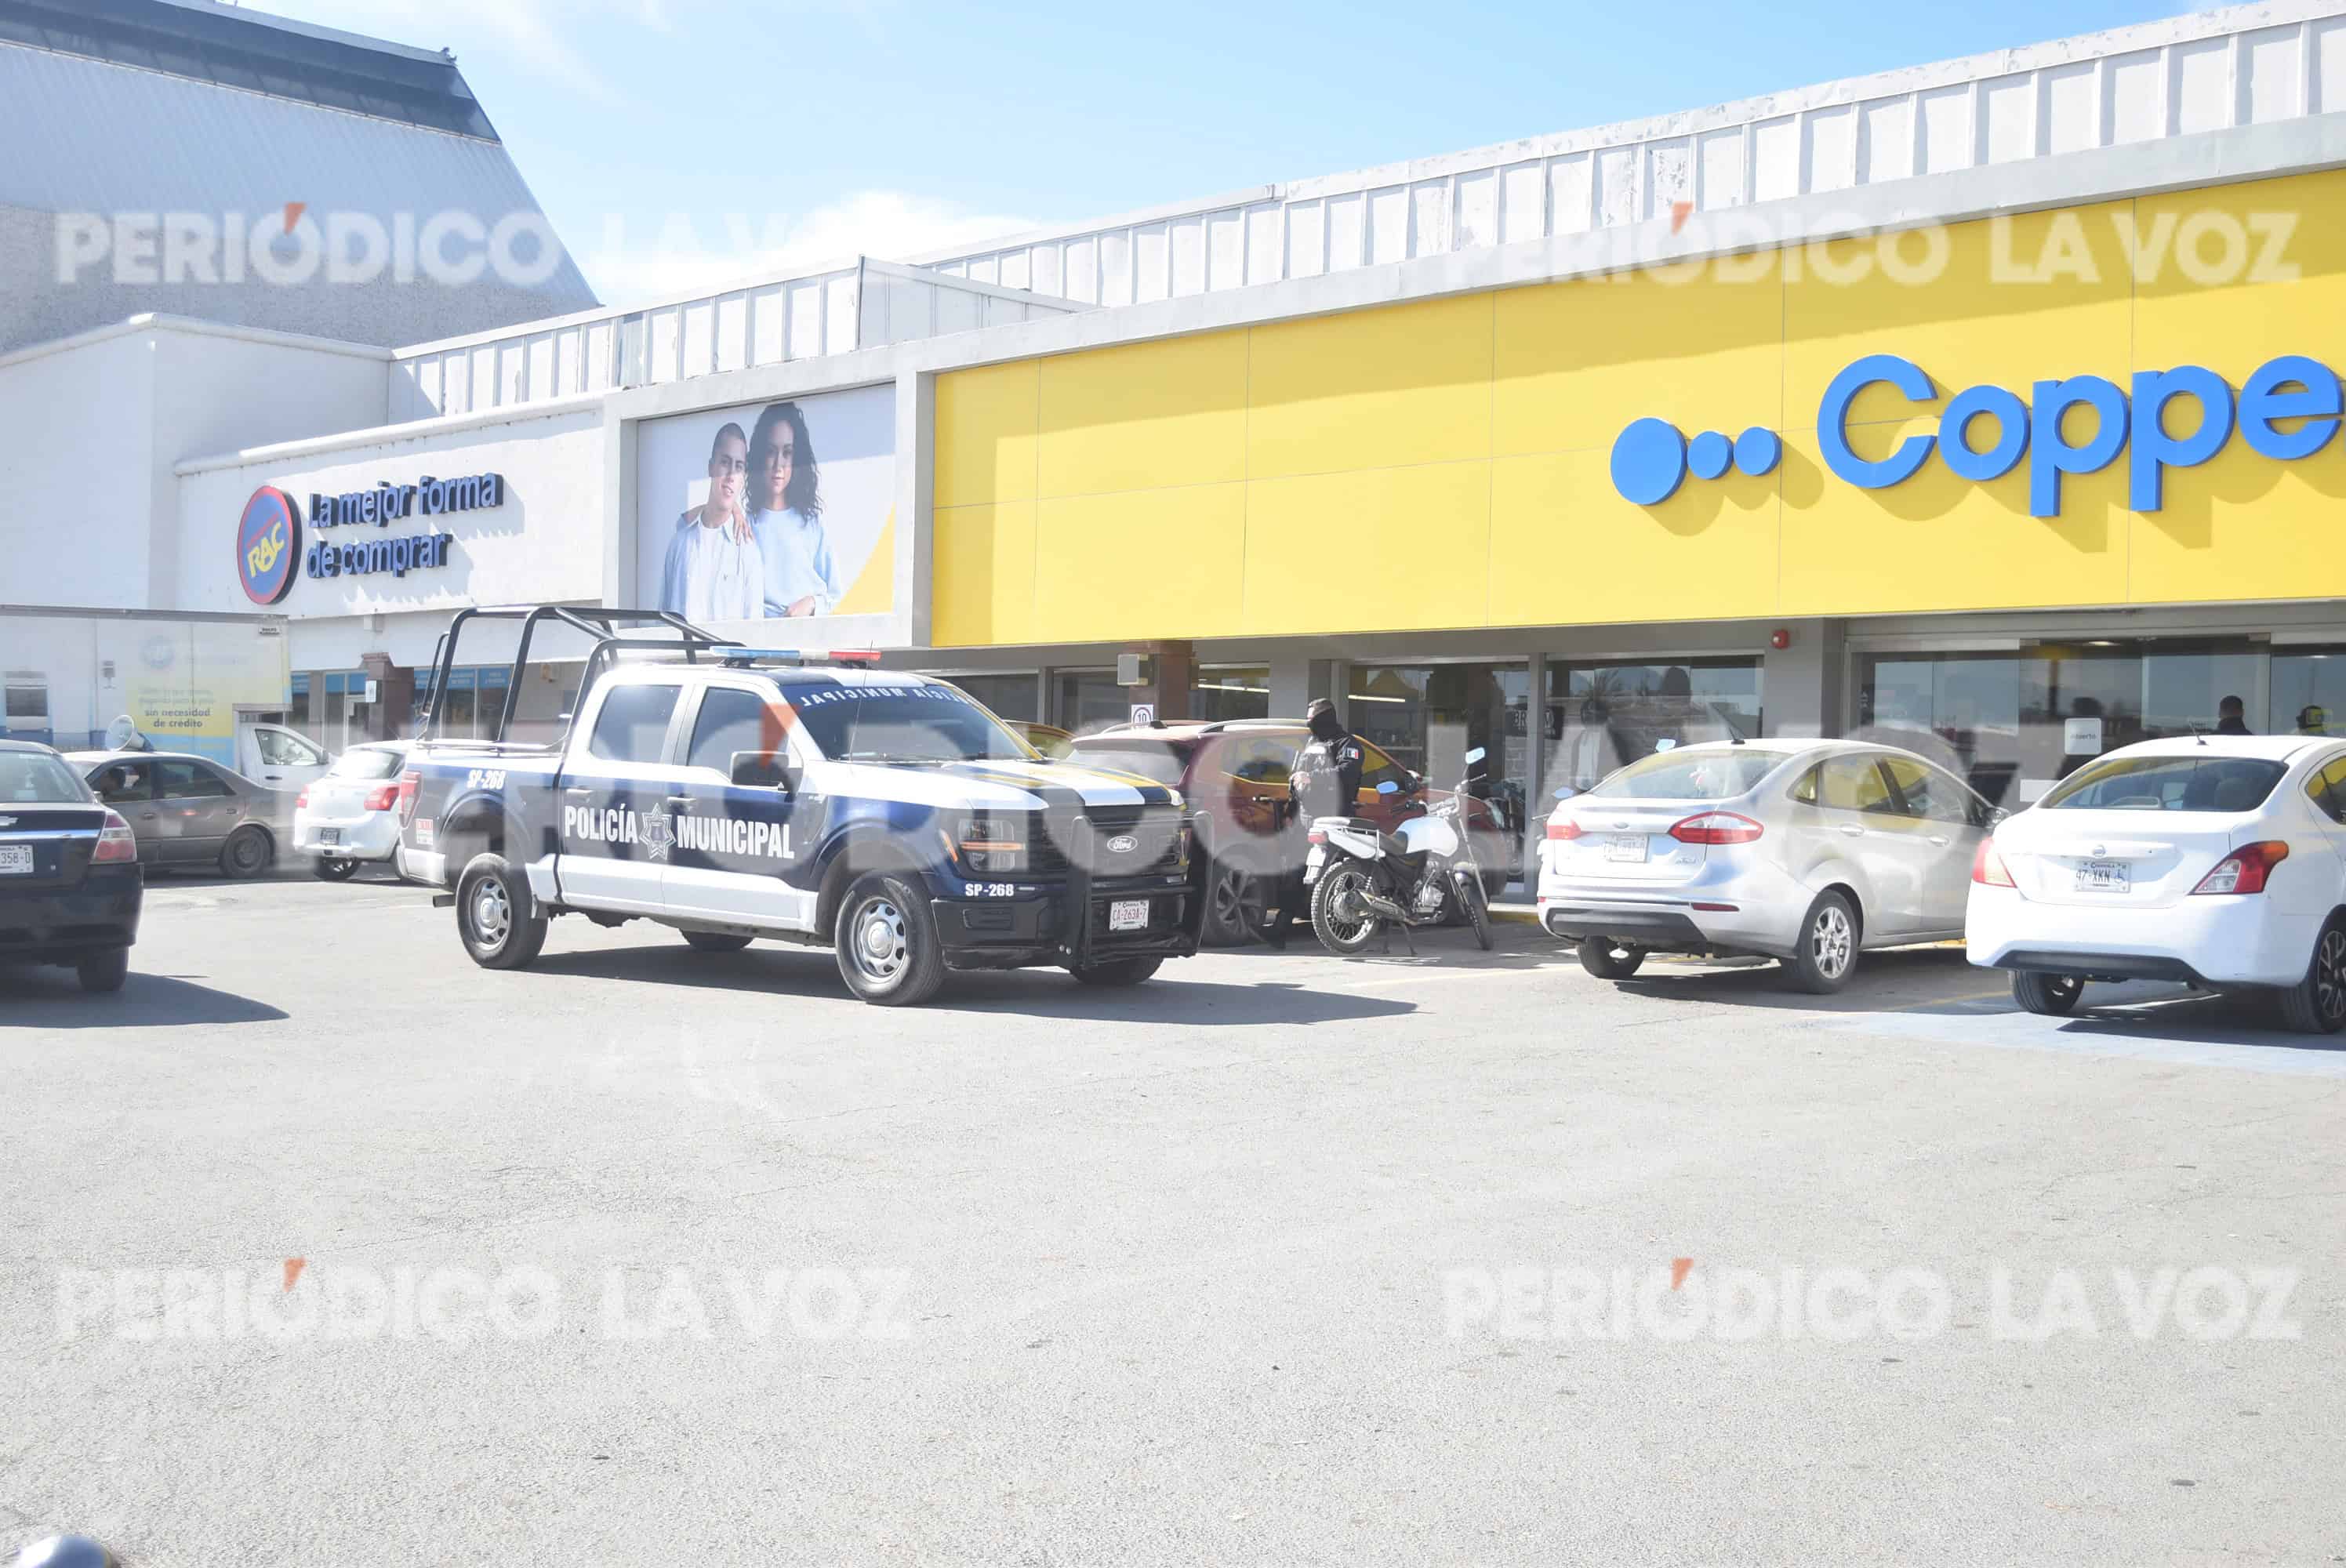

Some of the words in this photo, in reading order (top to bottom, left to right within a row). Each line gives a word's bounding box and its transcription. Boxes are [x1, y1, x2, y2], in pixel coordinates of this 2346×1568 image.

[307, 492, 338, 528] La
[339, 480, 416, 528] mejor
[418, 472, 503, 516] forma
[246, 521, 285, 578] RAC
[307, 540, 339, 578] de
[341, 533, 452, 577] comprar
[162, 707, 211, 717] necesidad
[1136, 713, 1147, 722] 10
[153, 718, 165, 728] de
[565, 802, 639, 846] POLICÍA
[676, 814, 795, 859] MUNICIPAL
[1111, 837, 1133, 849] Ford
[964, 882, 1015, 898] SP-268
